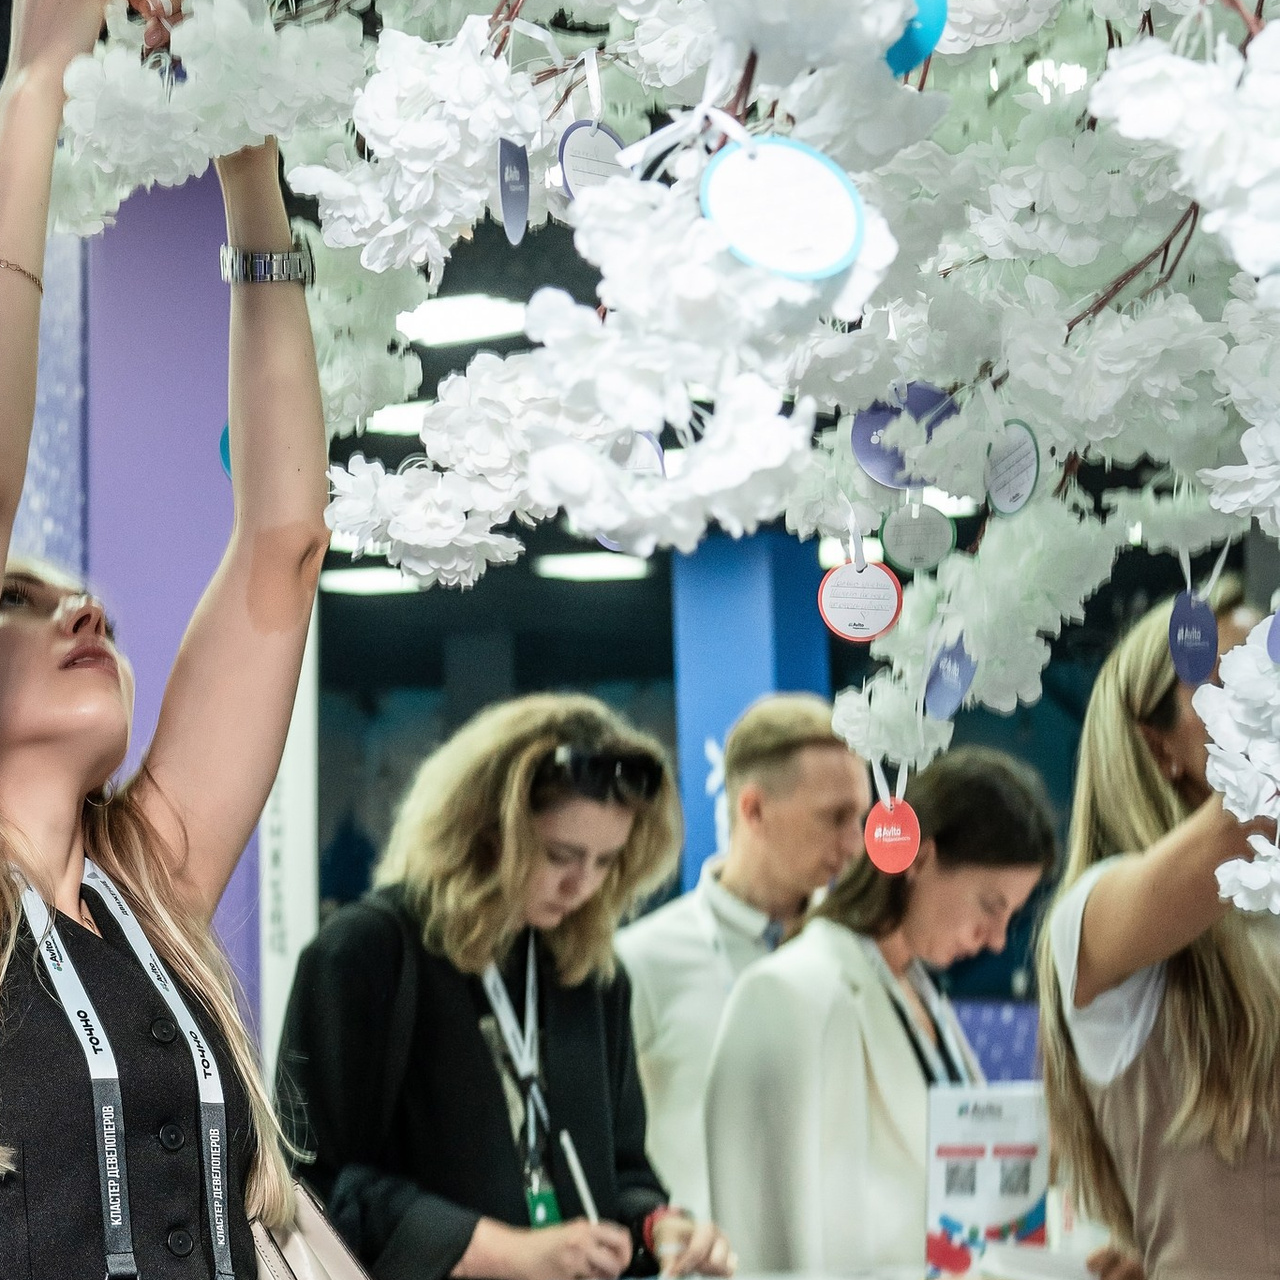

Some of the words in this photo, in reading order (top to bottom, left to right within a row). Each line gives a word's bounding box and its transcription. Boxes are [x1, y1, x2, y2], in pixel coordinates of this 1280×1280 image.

[882, 825, 902, 838] Avito
[45, 940, 59, 963] Avito
[149, 962, 165, 983] Avito
[76, 1008, 104, 1055] ТОЧНО
[188, 1030, 213, 1080] ТОЧНО
[102, 1105, 120, 1179] ДЕВЕЛОПЕРОВ
[209, 1128, 223, 1199] ДЕВЕЛОПЕРОВ
[108, 1179, 122, 1226] КЛАСТЕР
[213, 1201, 226, 1245] КЛАСТЕР
